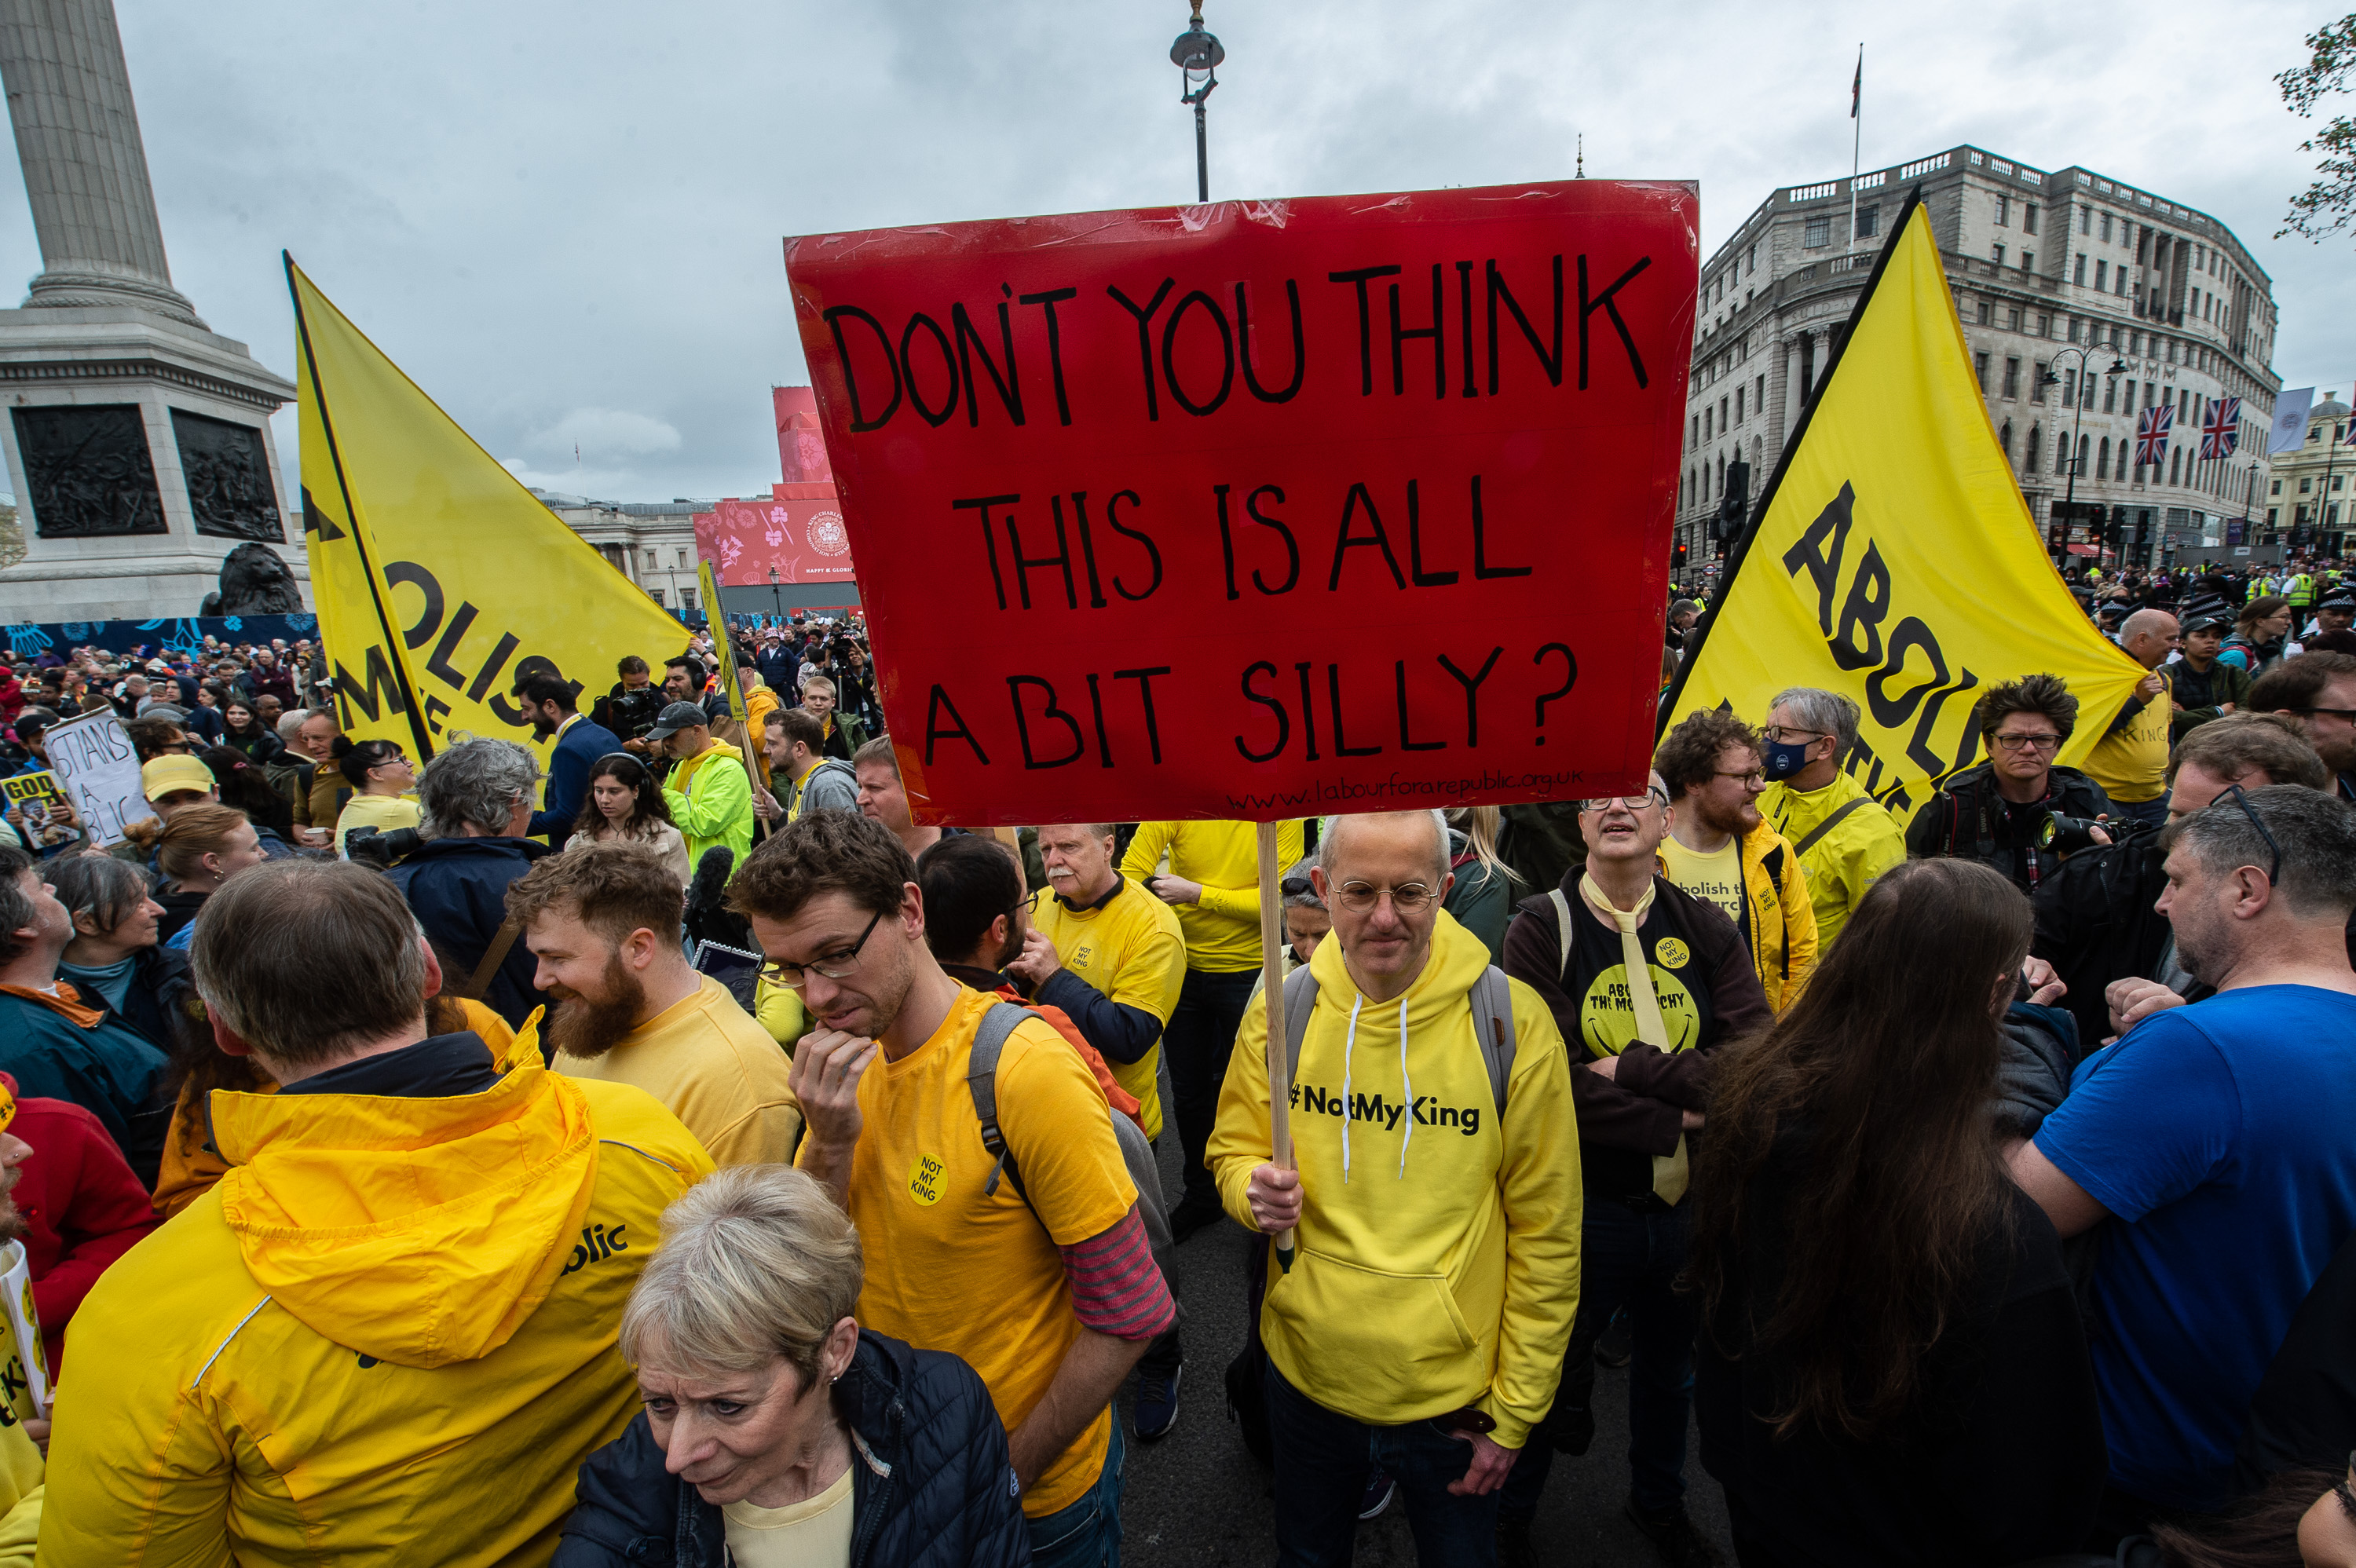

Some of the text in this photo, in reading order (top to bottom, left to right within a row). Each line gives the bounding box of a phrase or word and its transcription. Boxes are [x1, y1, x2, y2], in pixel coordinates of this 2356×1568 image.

[823, 254, 1652, 433] DON'T YOU THINK
[808, 513, 819, 526] KING
[806, 529, 829, 557] CORONATION
[952, 474, 1533, 611] THIS IS ALL
[1781, 478, 1990, 791] ABOLI
[925, 683, 990, 767] A
[1006, 666, 1171, 771] BIT
[2123, 726, 2166, 742] KING
[5, 774, 53, 799] GOD
[80, 784, 101, 807] A
[1758, 888, 1770, 900] NOT
[1763, 895, 1772, 905] MY
[1763, 900, 1776, 912] KING
[1078, 945, 1092, 955] NOT
[1659, 939, 1675, 952] NOT
[1666, 947, 1678, 959] MY
[1072, 957, 1088, 967] KING
[1077, 952, 1088, 960] MY
[1666, 952, 1688, 967] KING
[1608, 981, 1659, 998] ABOH
[1615, 992, 1685, 1013] MOCHY
[1290, 1082, 1480, 1137] #NotMyKing
[920, 1156, 943, 1176] NOT
[918, 1170, 936, 1186] MY
[910, 1179, 936, 1201] KING
